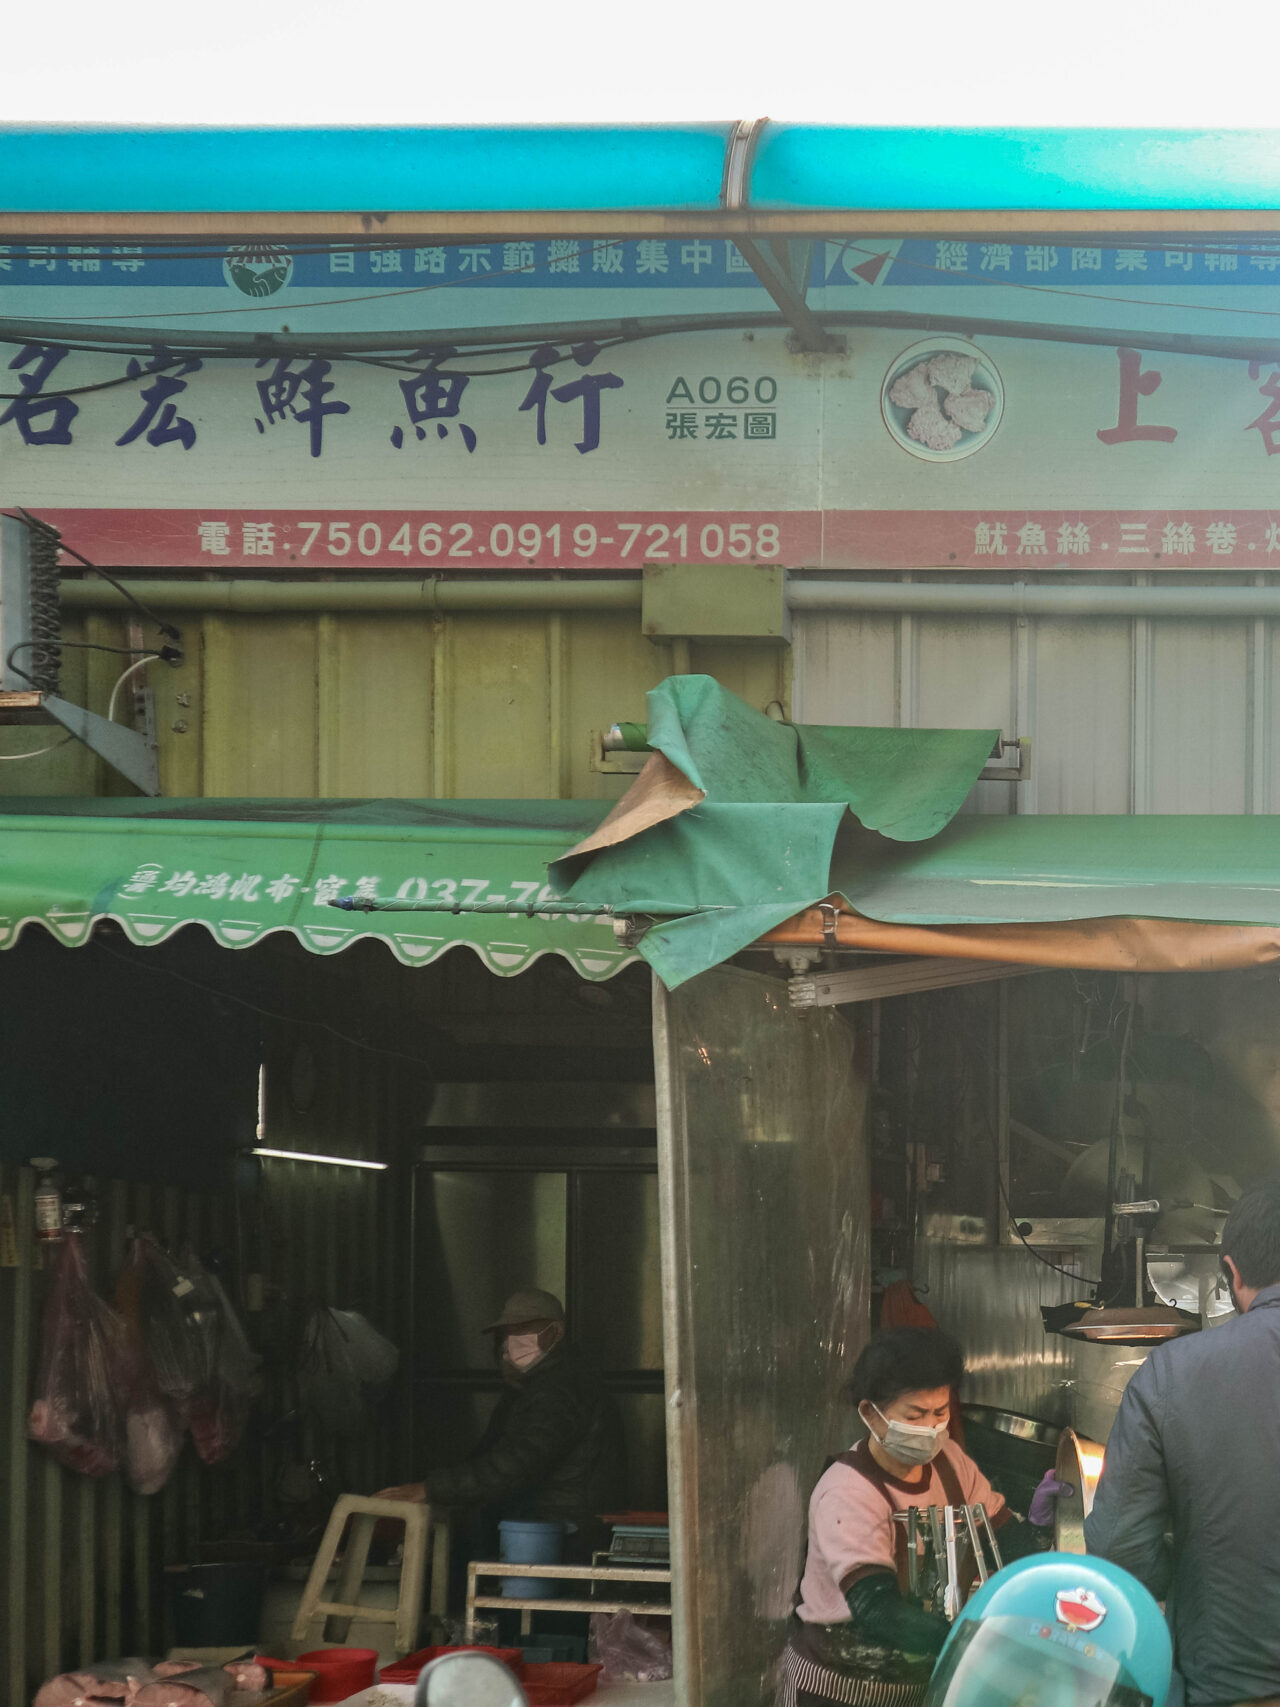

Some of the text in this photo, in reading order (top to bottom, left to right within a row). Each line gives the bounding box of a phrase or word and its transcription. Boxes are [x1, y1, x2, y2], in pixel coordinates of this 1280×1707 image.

[666, 375, 778, 404] A060
[666, 412, 777, 440] 張宏圖
